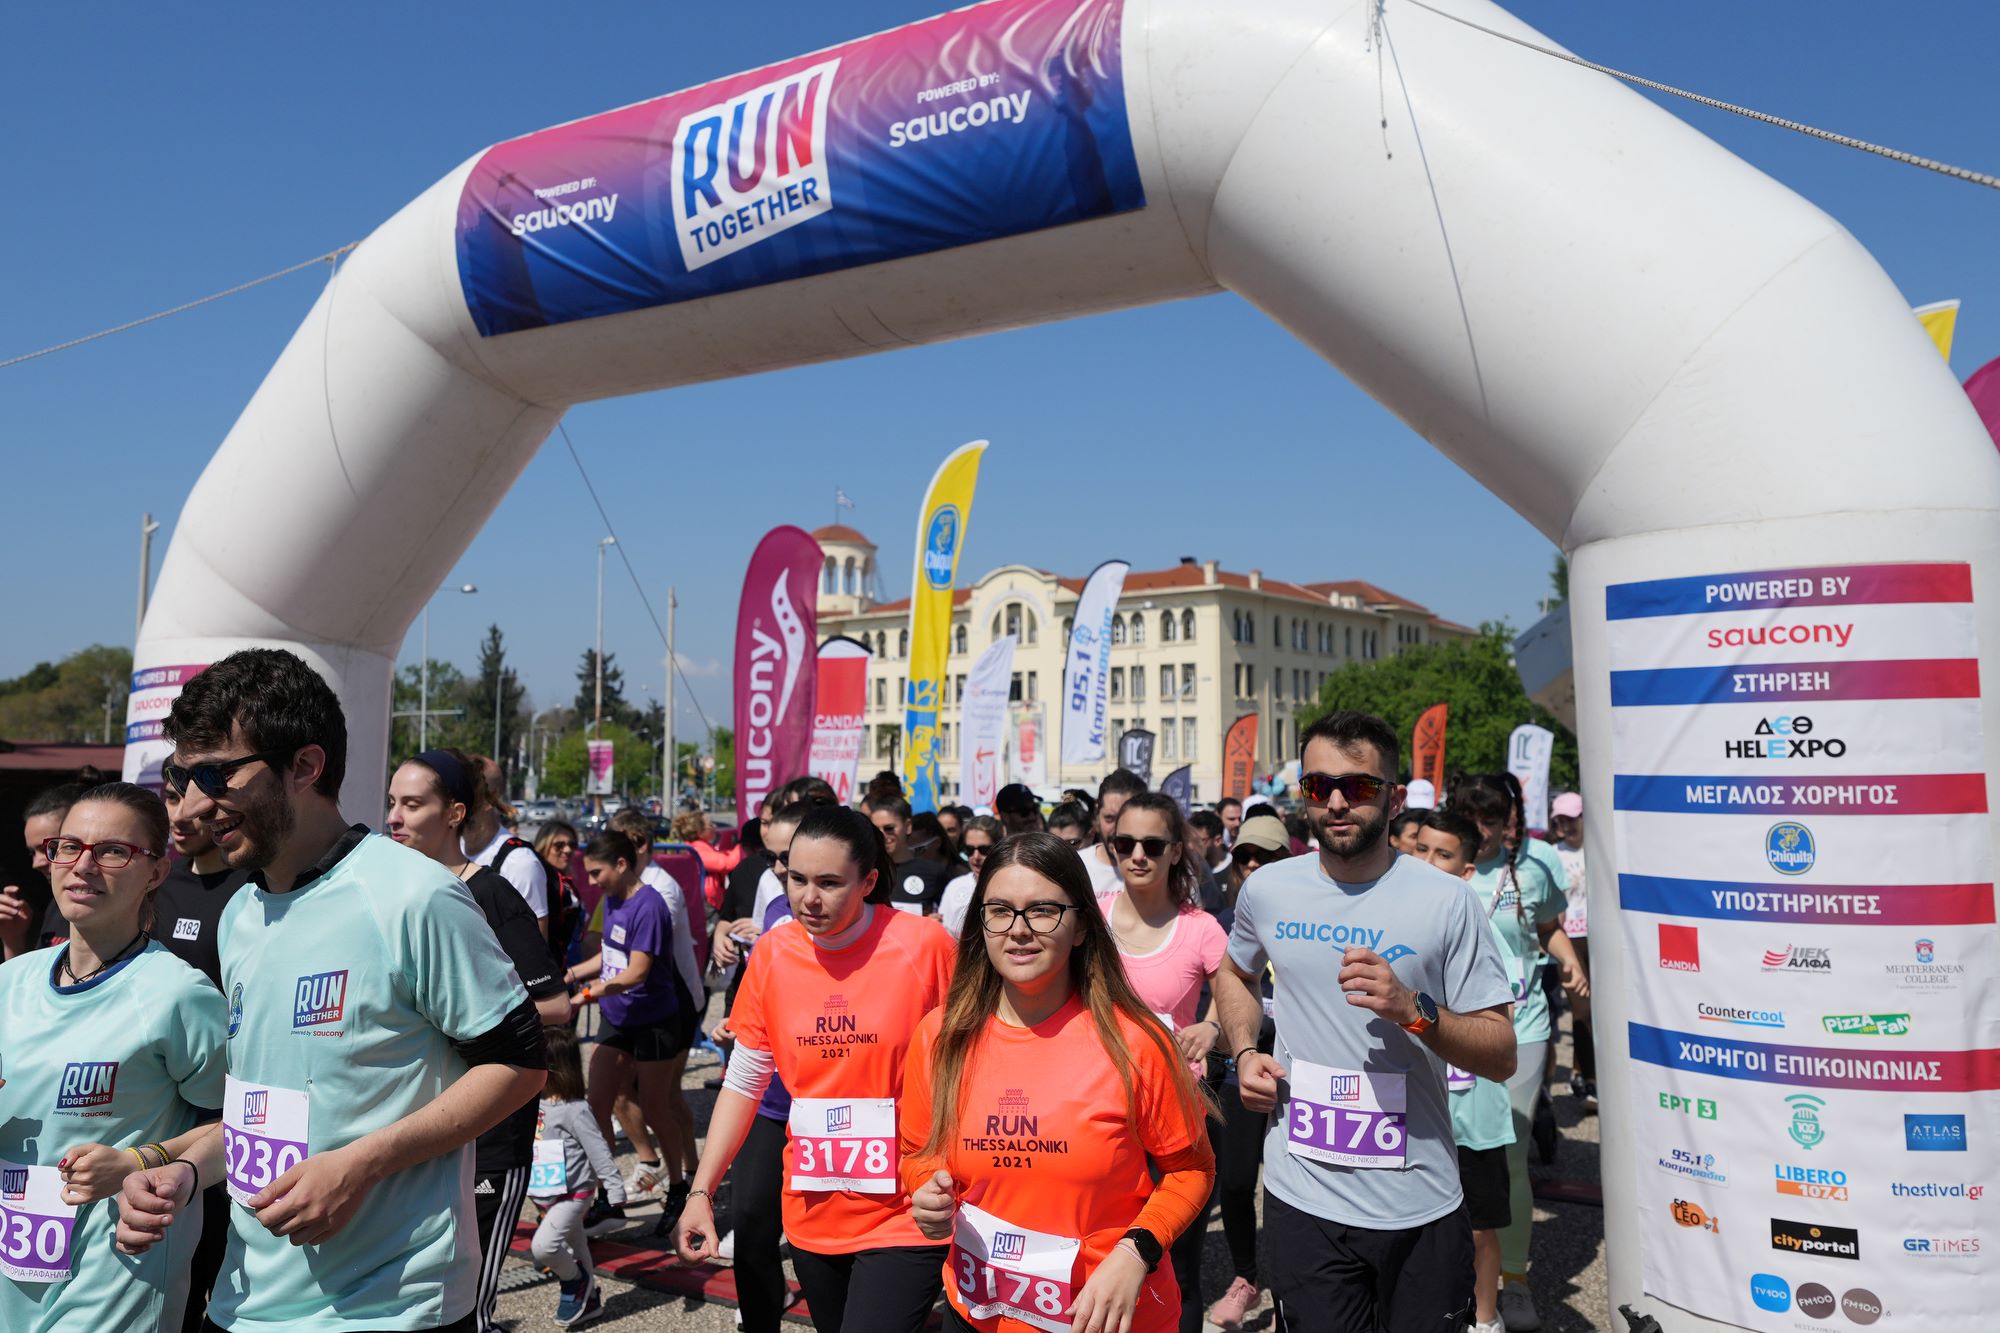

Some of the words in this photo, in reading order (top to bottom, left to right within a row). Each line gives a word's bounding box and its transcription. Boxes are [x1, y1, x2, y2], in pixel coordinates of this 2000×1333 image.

[917, 77, 977, 103] POWERED
[889, 88, 1031, 147] saucony
[684, 68, 825, 219] RUN
[511, 193, 618, 236] saucony
[690, 178, 819, 254] TOGETHER
[1706, 578, 1813, 603] POWERED
[1822, 577, 1851, 597] BY
[1707, 622, 1854, 648] saucony
[1733, 671, 1830, 693] ΣΤΗΡΙΞΗ
[745, 627, 783, 821] aucony
[1725, 738, 1846, 759] HELEXPO
[1686, 785, 1785, 805] ΜΕΓΑΛΟΣ
[1791, 785, 1899, 805] ΧΟΡΗΓΟΣ
[1769, 850, 1814, 867] Chiquita
[1711, 889, 1882, 915] ΥΠΟΣΤΗΡΙΚΤΕΣ
[175, 920, 200, 936] 3182
[1275, 921, 1384, 949] saucony
[1660, 959, 1698, 971] CANDIA
[1788, 958, 1832, 969] ΑΛΦΑ
[1885, 965, 1965, 974] MEDITERRANEAN
[1905, 975, 1949, 984] COLLEGE
[296, 974, 344, 1013] RUN
[296, 1010, 339, 1024] TOGETHER
[1698, 1003, 1784, 1024] Countercool
[312, 1029, 345, 1038] saucony
[816, 1015, 856, 1033] RUN
[796, 1033, 878, 1046] THESSALONIKI
[821, 1048, 850, 1058] 2021
[1680, 1040, 1767, 1072] ΧΟΡΗΓΟΙ
[1775, 1054, 1942, 1080] ΕΠΙΚΟΙΝΩΝΙΑΣ
[62, 1066, 114, 1096] RUN
[1332, 1076, 1358, 1095] RUN
[61, 1095, 110, 1106] TOGETHER
[245, 1091, 267, 1117] RUN
[1699, 1101, 1713, 1117] 3
[80, 1110, 114, 1118] saucony
[828, 1107, 850, 1126] RUN
[986, 1115, 1038, 1136] RUN
[1292, 1101, 1402, 1151] 3176
[1797, 1122, 1816, 1134] 102
[1912, 1125, 1961, 1137] ATLAS
[963, 1138, 1068, 1153] THESSALONIKI
[799, 1139, 889, 1174] 3178
[993, 1156, 1032, 1168] 2021
[1358, 1156, 1379, 1164] ΝΙΚΟΣ
[4, 1170, 27, 1193] RUN
[529, 1164, 561, 1186] 32
[1775, 1164, 1847, 1185] LIBERO
[1892, 1183, 1984, 1200] thestival.gr
[1674, 1206, 1701, 1225] LEO
[995, 1234, 1025, 1256] RUN
[1773, 1234, 1856, 1255] cityportal
[993, 1251, 1022, 1260] TOGETHER
[959, 1252, 1063, 1316] 3178
[1754, 1286, 1788, 1300] TV100
[1798, 1295, 1833, 1308] FM100
